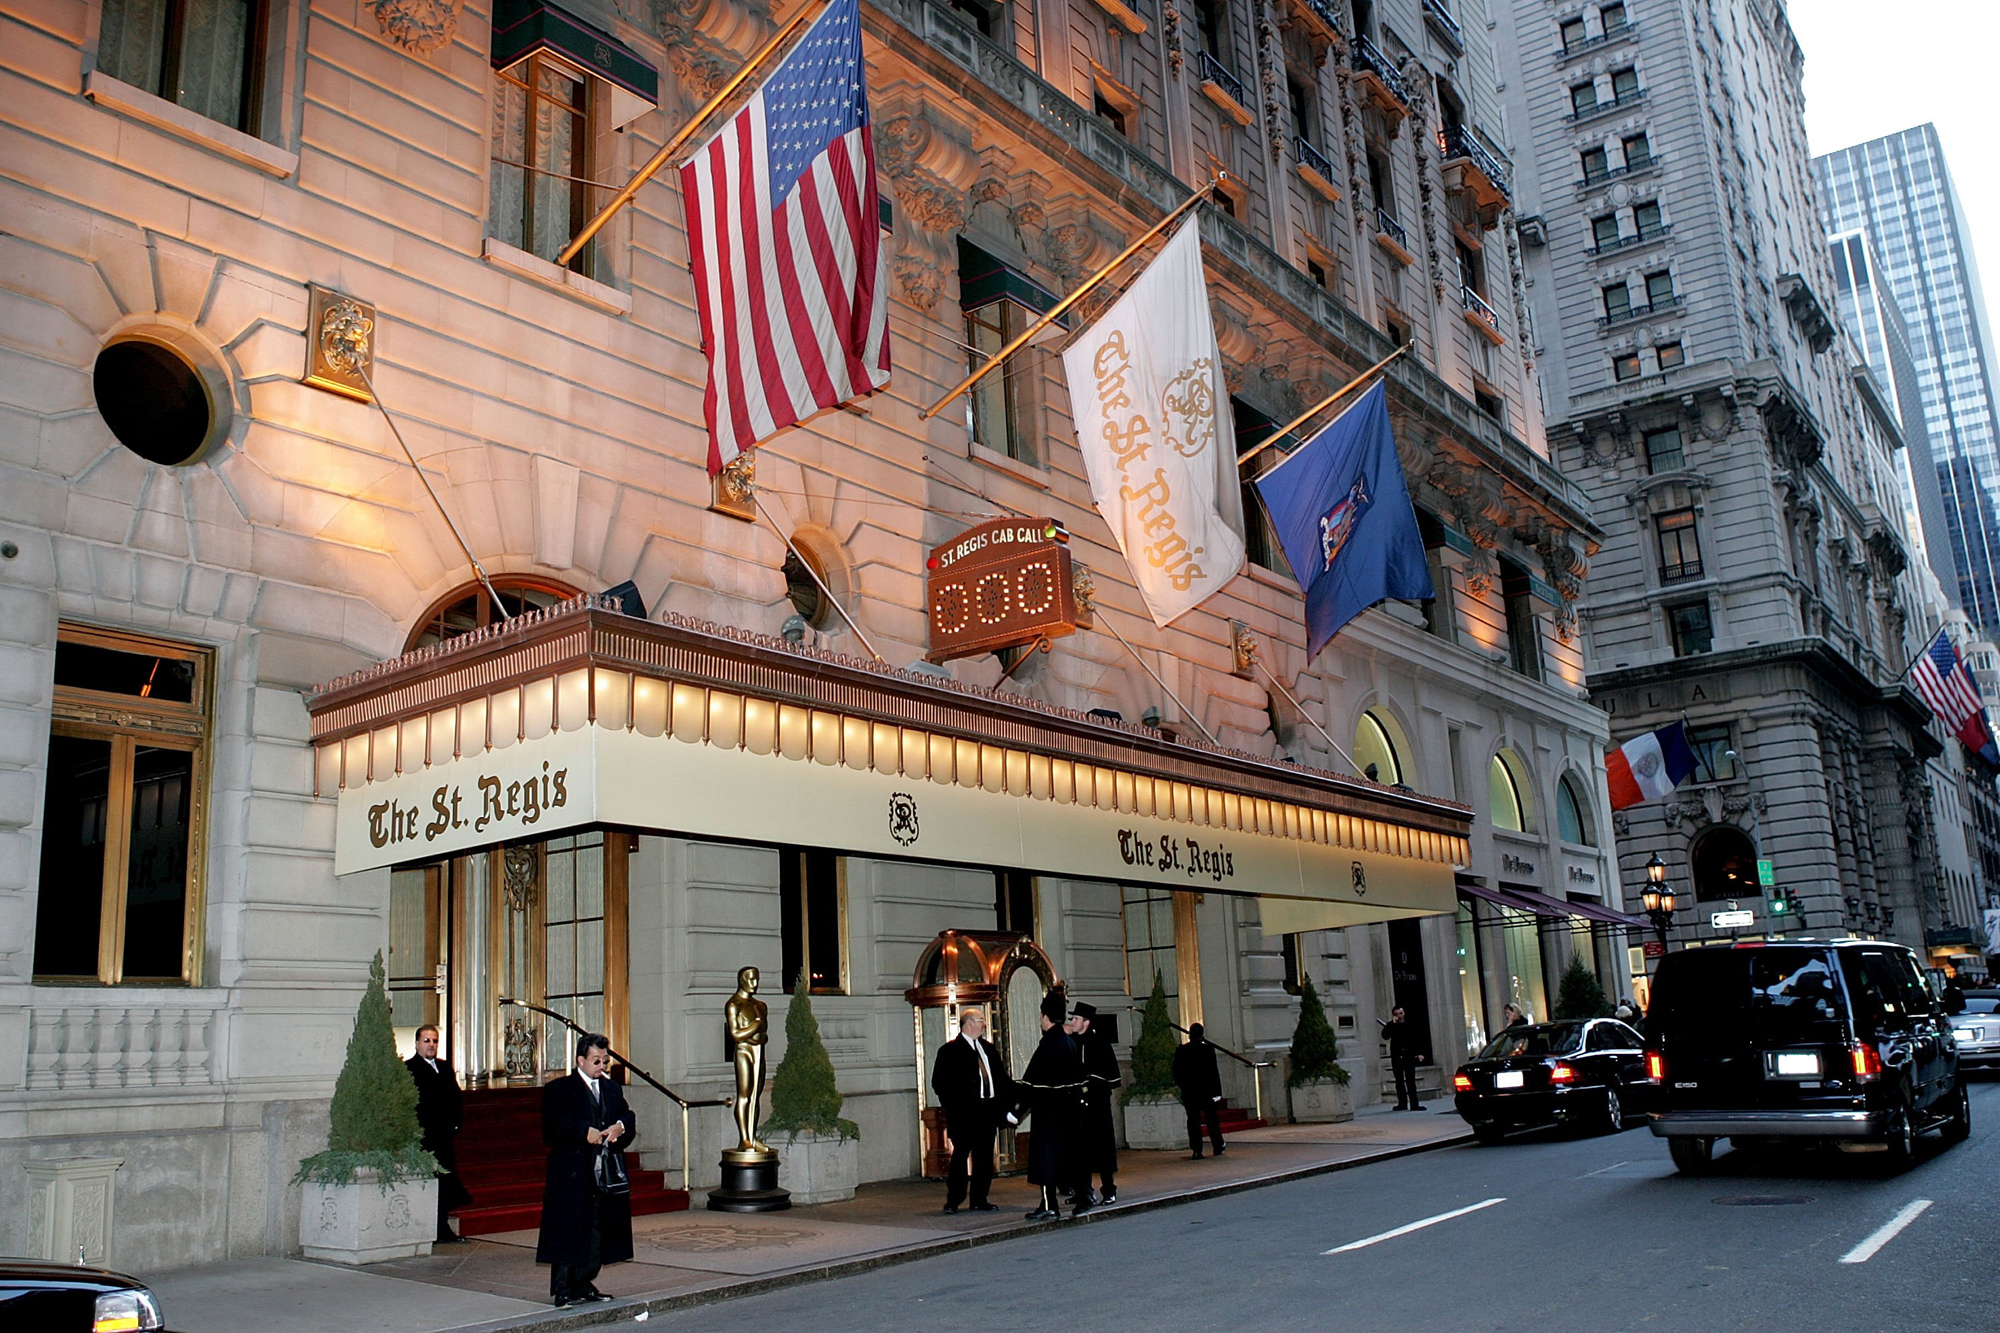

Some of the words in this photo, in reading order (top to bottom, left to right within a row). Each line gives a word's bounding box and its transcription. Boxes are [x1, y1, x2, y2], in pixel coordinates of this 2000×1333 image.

[1093, 329, 1133, 420] The
[1102, 414, 1152, 483] St.
[940, 548, 956, 568] ST.
[956, 533, 988, 560] REGIS
[991, 527, 1014, 544] CAB
[1016, 527, 1044, 543] CALL
[1119, 467, 1208, 592] Regis
[367, 798, 419, 849] The
[425, 784, 469, 842] St.
[475, 760, 568, 833] Regis
[1117, 828, 1154, 866] The
[1158, 834, 1184, 872] St.
[1186, 837, 1234, 882] Regis
